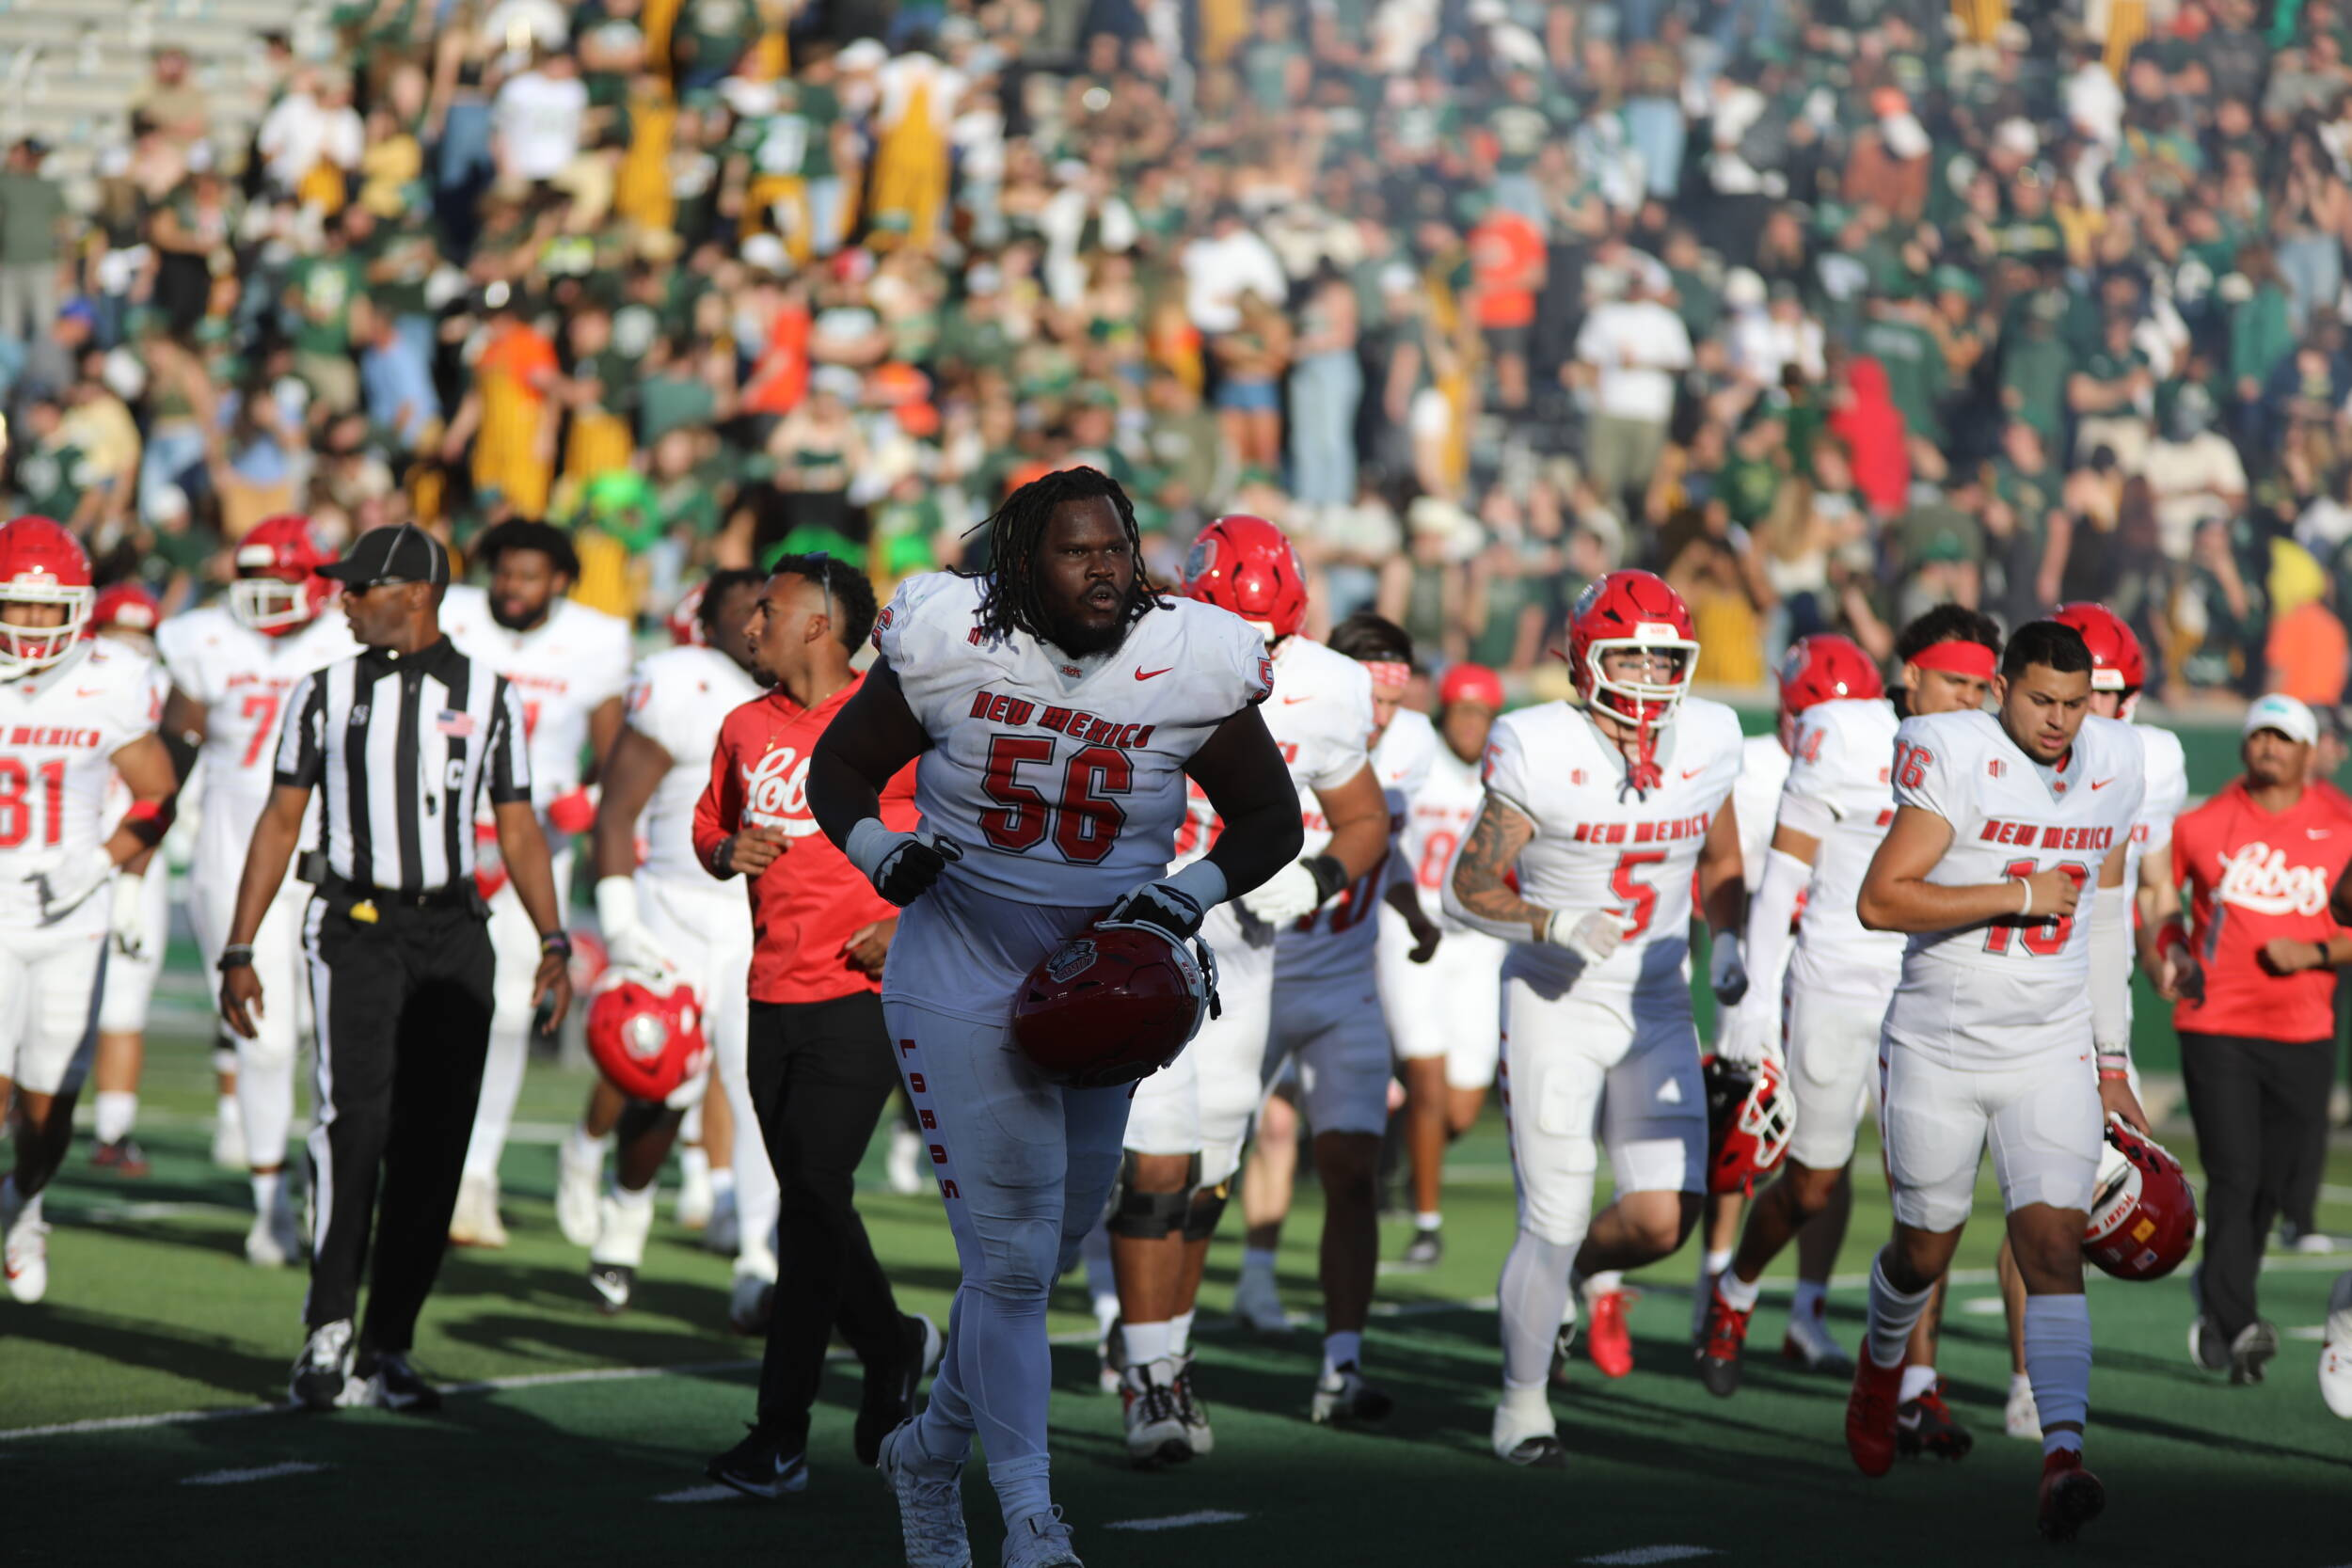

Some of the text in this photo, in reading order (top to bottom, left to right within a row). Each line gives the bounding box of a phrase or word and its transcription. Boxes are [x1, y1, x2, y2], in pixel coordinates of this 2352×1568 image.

[242, 695, 280, 768] 7
[969, 690, 1156, 749] NEW MEXICO
[445, 758, 466, 790] C
[1892, 738, 1934, 790] 16
[977, 734, 1135, 866] 56
[1573, 812, 1709, 845] NEW MEXICO
[1979, 818, 2039, 847] NEW
[2040, 825, 2114, 850] MEXICO
[1601, 848, 1670, 944] 5
[2215, 842, 2328, 916] Lobos
[898, 1038, 961, 1200] LOBOS
